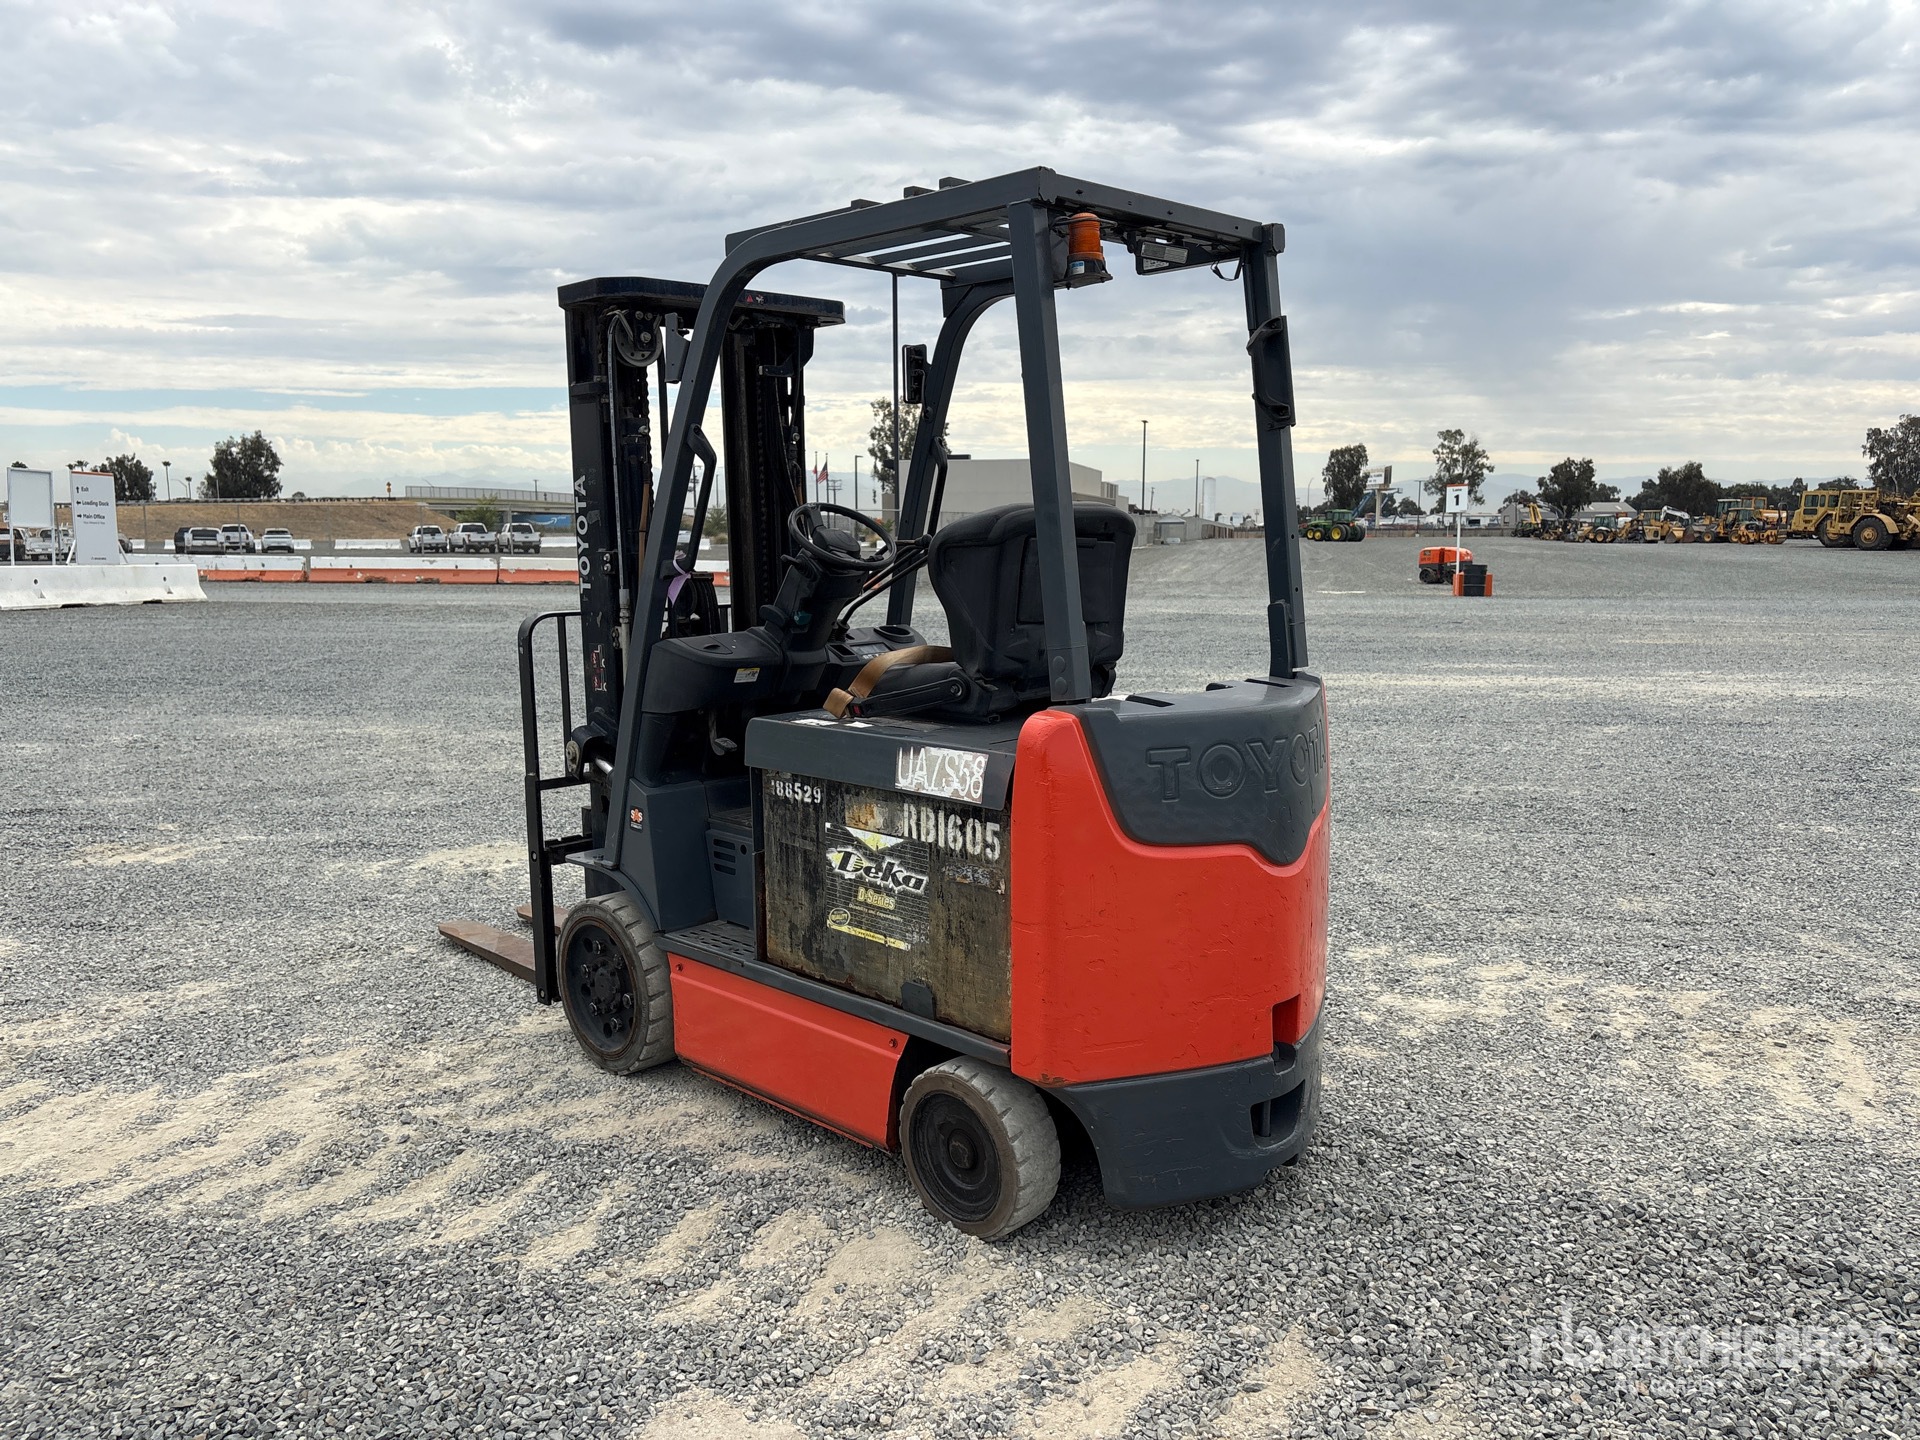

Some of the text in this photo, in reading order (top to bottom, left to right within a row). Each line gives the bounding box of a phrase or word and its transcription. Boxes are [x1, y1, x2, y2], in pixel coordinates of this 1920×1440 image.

[1454, 494, 1459, 506] 1
[574, 474, 592, 594] TOYOTA
[836, 849, 925, 891] Deka
[857, 886, 896, 910] D-Series
